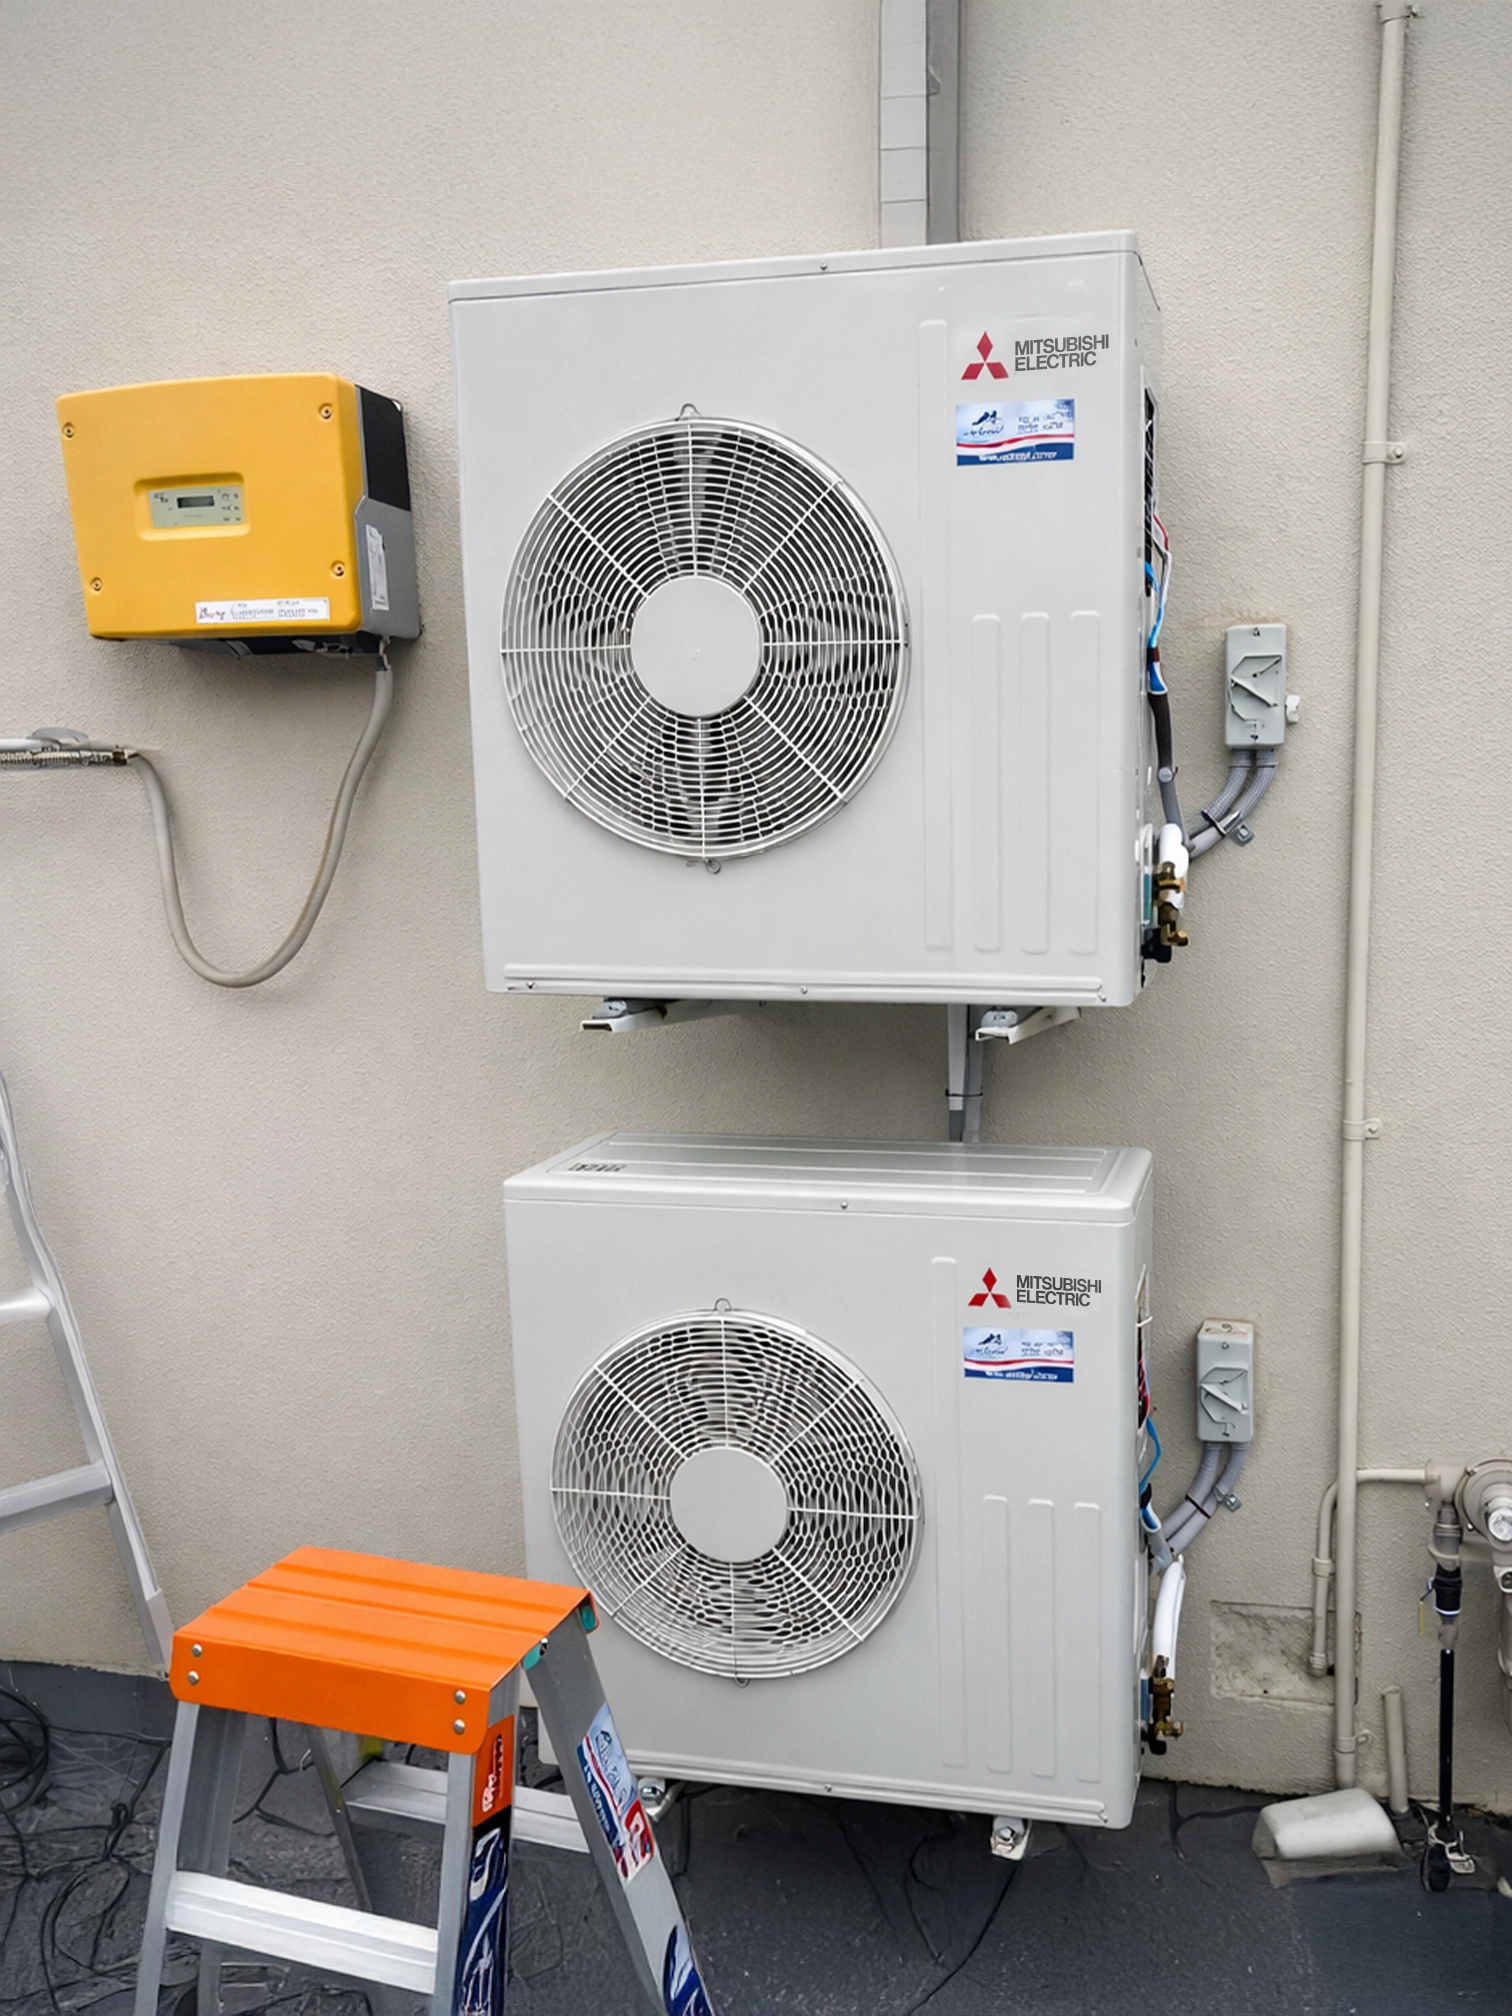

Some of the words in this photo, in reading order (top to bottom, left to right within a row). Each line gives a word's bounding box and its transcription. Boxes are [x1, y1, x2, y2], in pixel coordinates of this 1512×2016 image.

[1015, 334, 1109, 356] MITSUBISHI
[1015, 351, 1097, 372] ELECTRIC
[1016, 1274, 1102, 1293] MITSUBISHI
[1016, 1289, 1091, 1307] ELECTRIC
